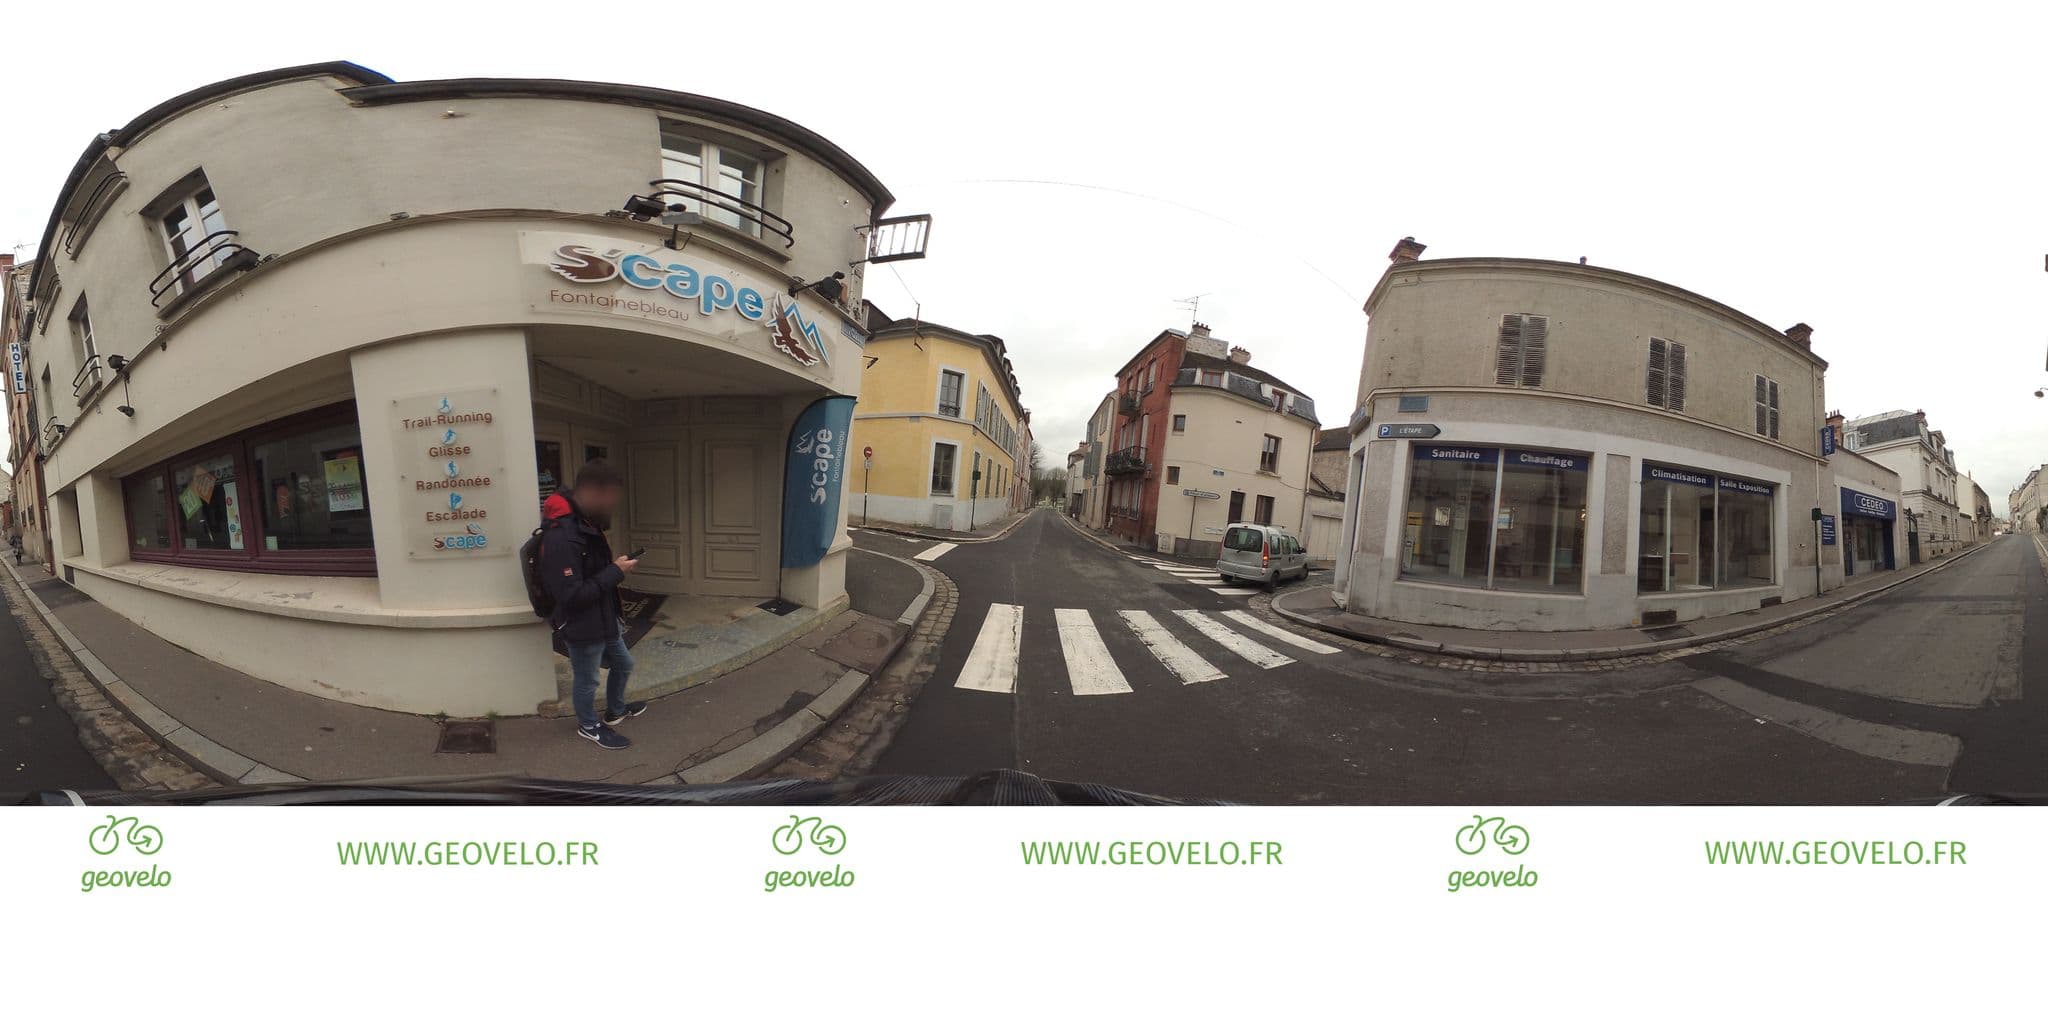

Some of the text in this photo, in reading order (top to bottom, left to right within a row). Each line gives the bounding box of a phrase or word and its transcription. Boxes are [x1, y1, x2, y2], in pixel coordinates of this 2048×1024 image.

[550, 289, 689, 321] Fontainebleau
[11, 344, 24, 391] HOTEL
[402, 411, 493, 430] Trail-Running
[429, 446, 471, 458] Glisse
[1431, 449, 1480, 460] Sanitaire
[1519, 453, 1574, 468] Chauffage
[416, 476, 490, 491] Randonnée
[1651, 469, 1707, 484] Climatisation
[1720, 479, 1770, 494] Salle Exposition
[1861, 497, 1884, 510] CEDEO
[426, 509, 487, 522] Escalade
